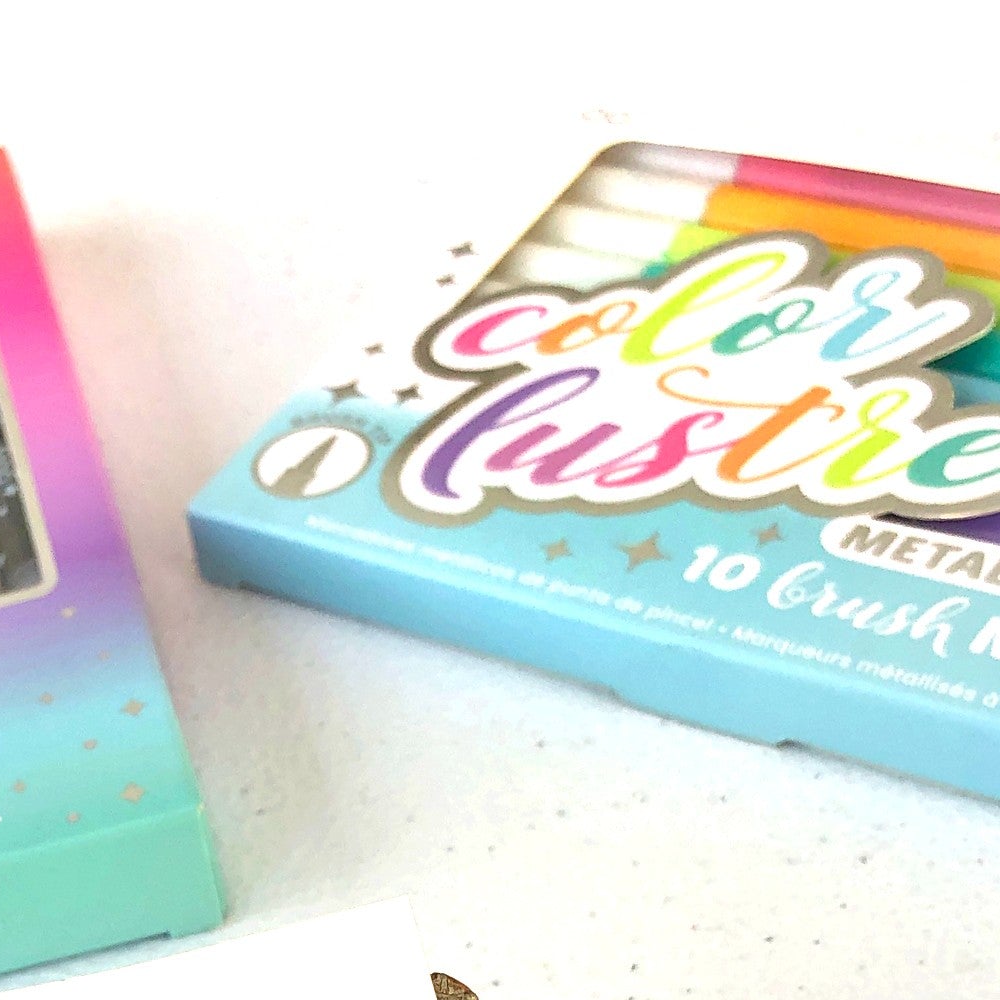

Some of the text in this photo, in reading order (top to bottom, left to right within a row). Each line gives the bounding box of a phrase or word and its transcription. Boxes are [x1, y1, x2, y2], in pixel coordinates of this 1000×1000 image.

[452, 252, 946, 365] color
[421, 366, 1000, 499] lustre
[682, 543, 761, 591] 10
[766, 560, 970, 659] brush
